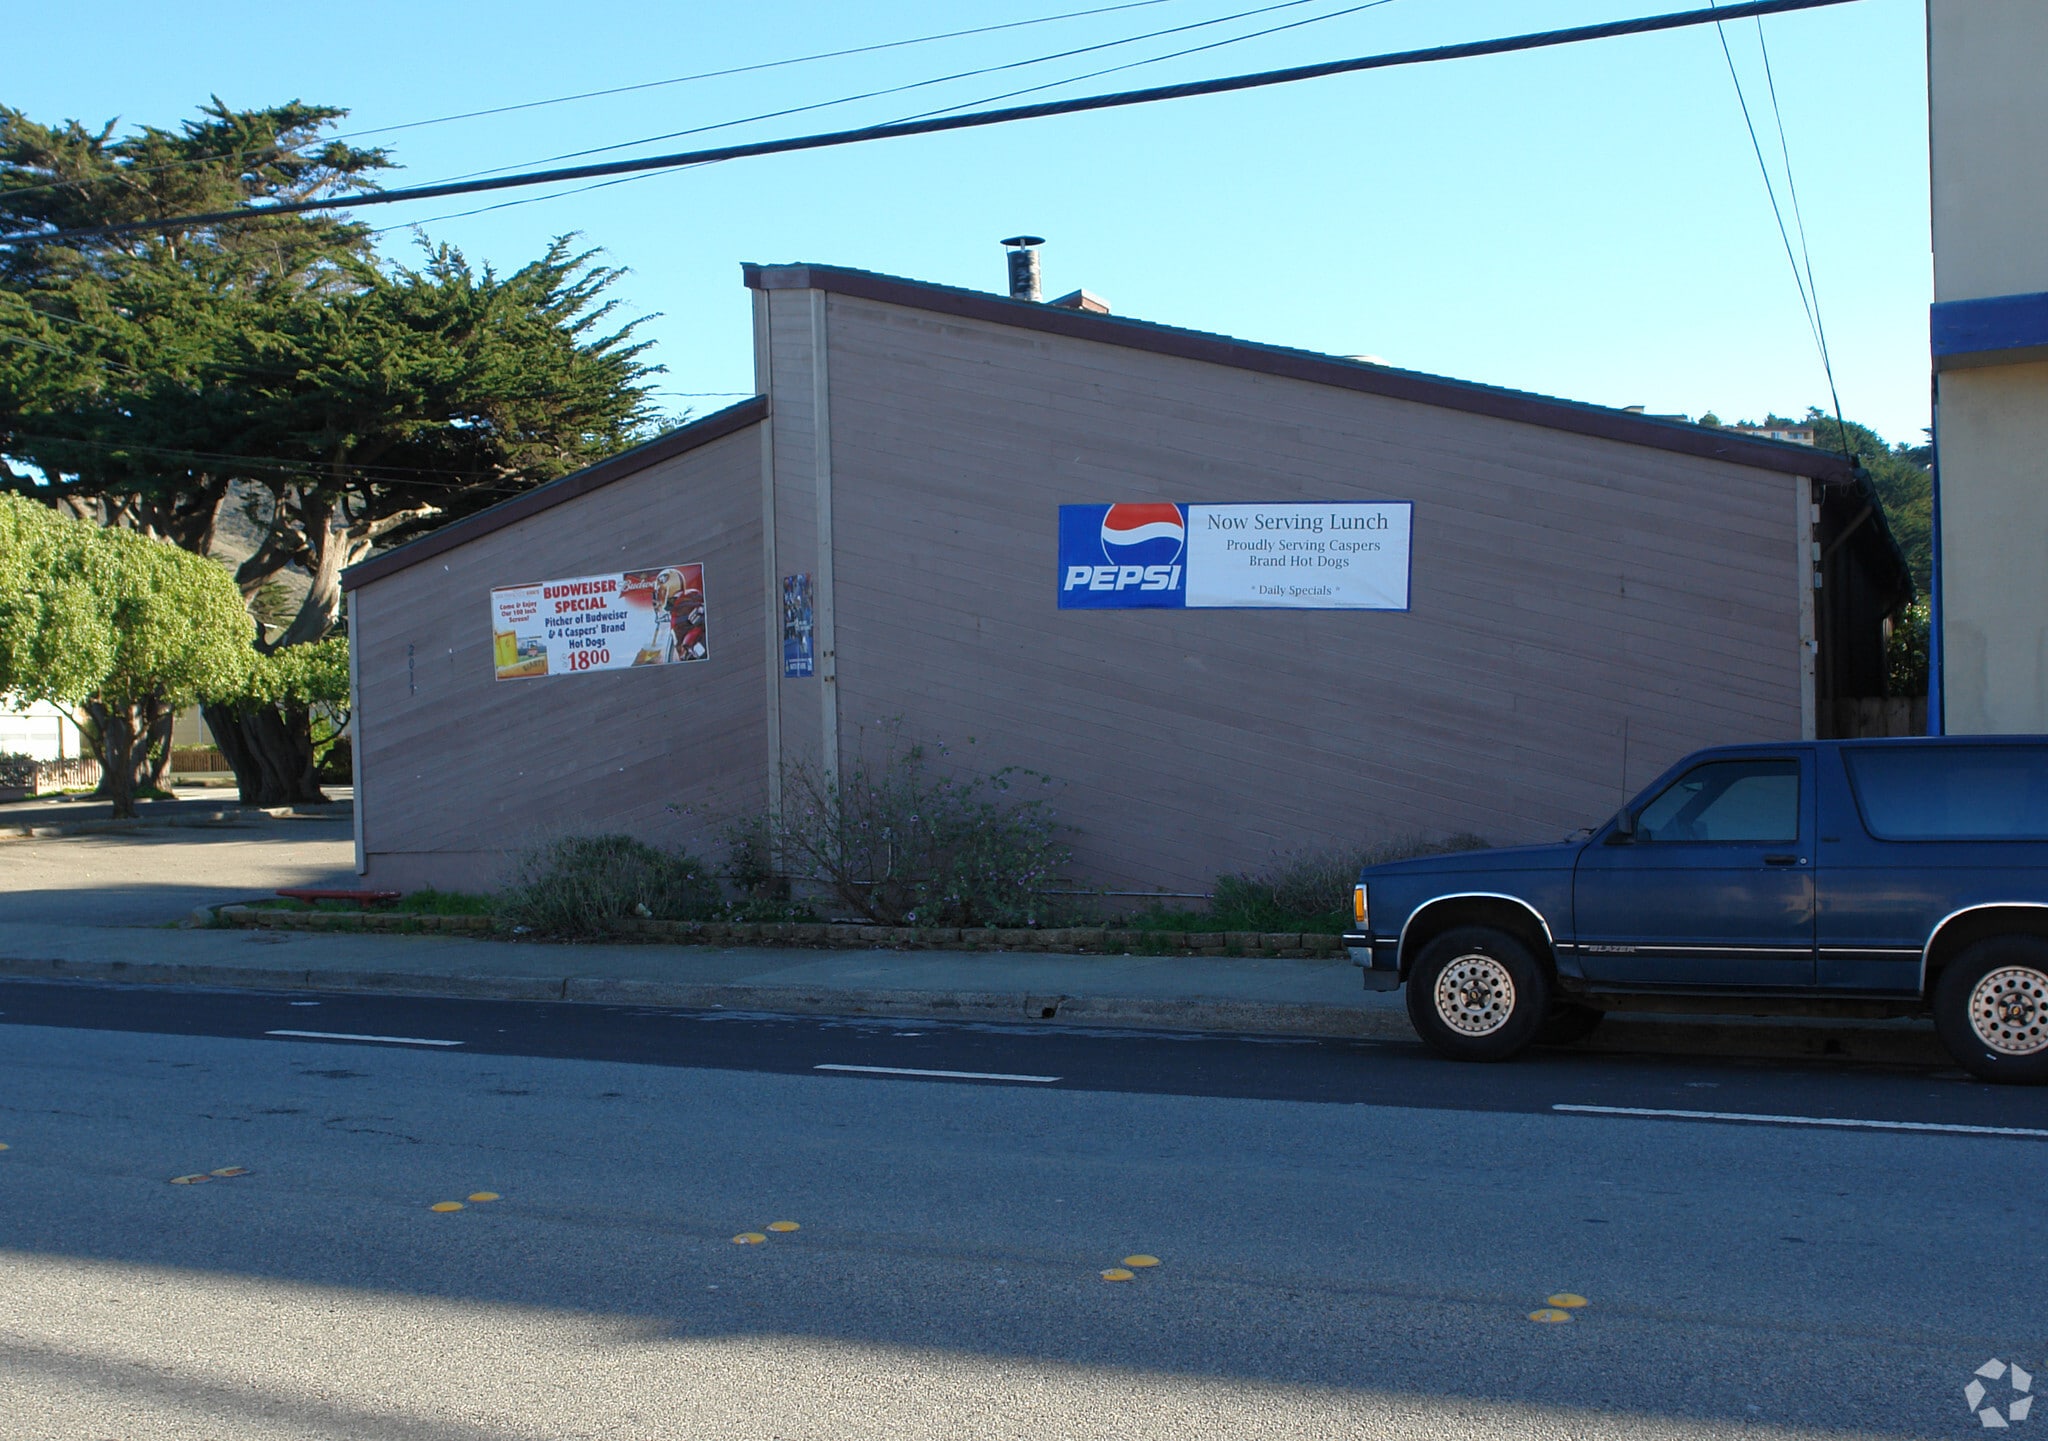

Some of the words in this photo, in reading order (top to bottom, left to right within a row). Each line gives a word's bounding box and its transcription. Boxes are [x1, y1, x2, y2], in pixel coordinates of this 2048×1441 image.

[1207, 514, 1248, 530] Now
[1254, 513, 1324, 533] Serving
[1330, 512, 1389, 530] Lunch
[1227, 539, 1275, 552] Proudly
[1279, 540, 1325, 553] Serving
[1329, 540, 1381, 553] Caspers
[1249, 556, 1286, 567] Brand
[1290, 555, 1313, 567] Hot
[1317, 556, 1350, 569] Dogs
[1063, 565, 1182, 591] PEPSI
[543, 579, 617, 599] BUDWEISER
[1259, 585, 1285, 596] Daily
[1289, 585, 1332, 596] Specials
[555, 596, 607, 613] SPECIAL
[544, 617, 573, 627] Pitcher
[575, 613, 584, 624] of
[586, 610, 628, 623] Budweiser
[548, 630, 556, 639] &
[558, 628, 563, 638] 4
[601, 621, 626, 634] Brand
[569, 639, 584, 649] Hot
[585, 637, 606, 648] Dogs
